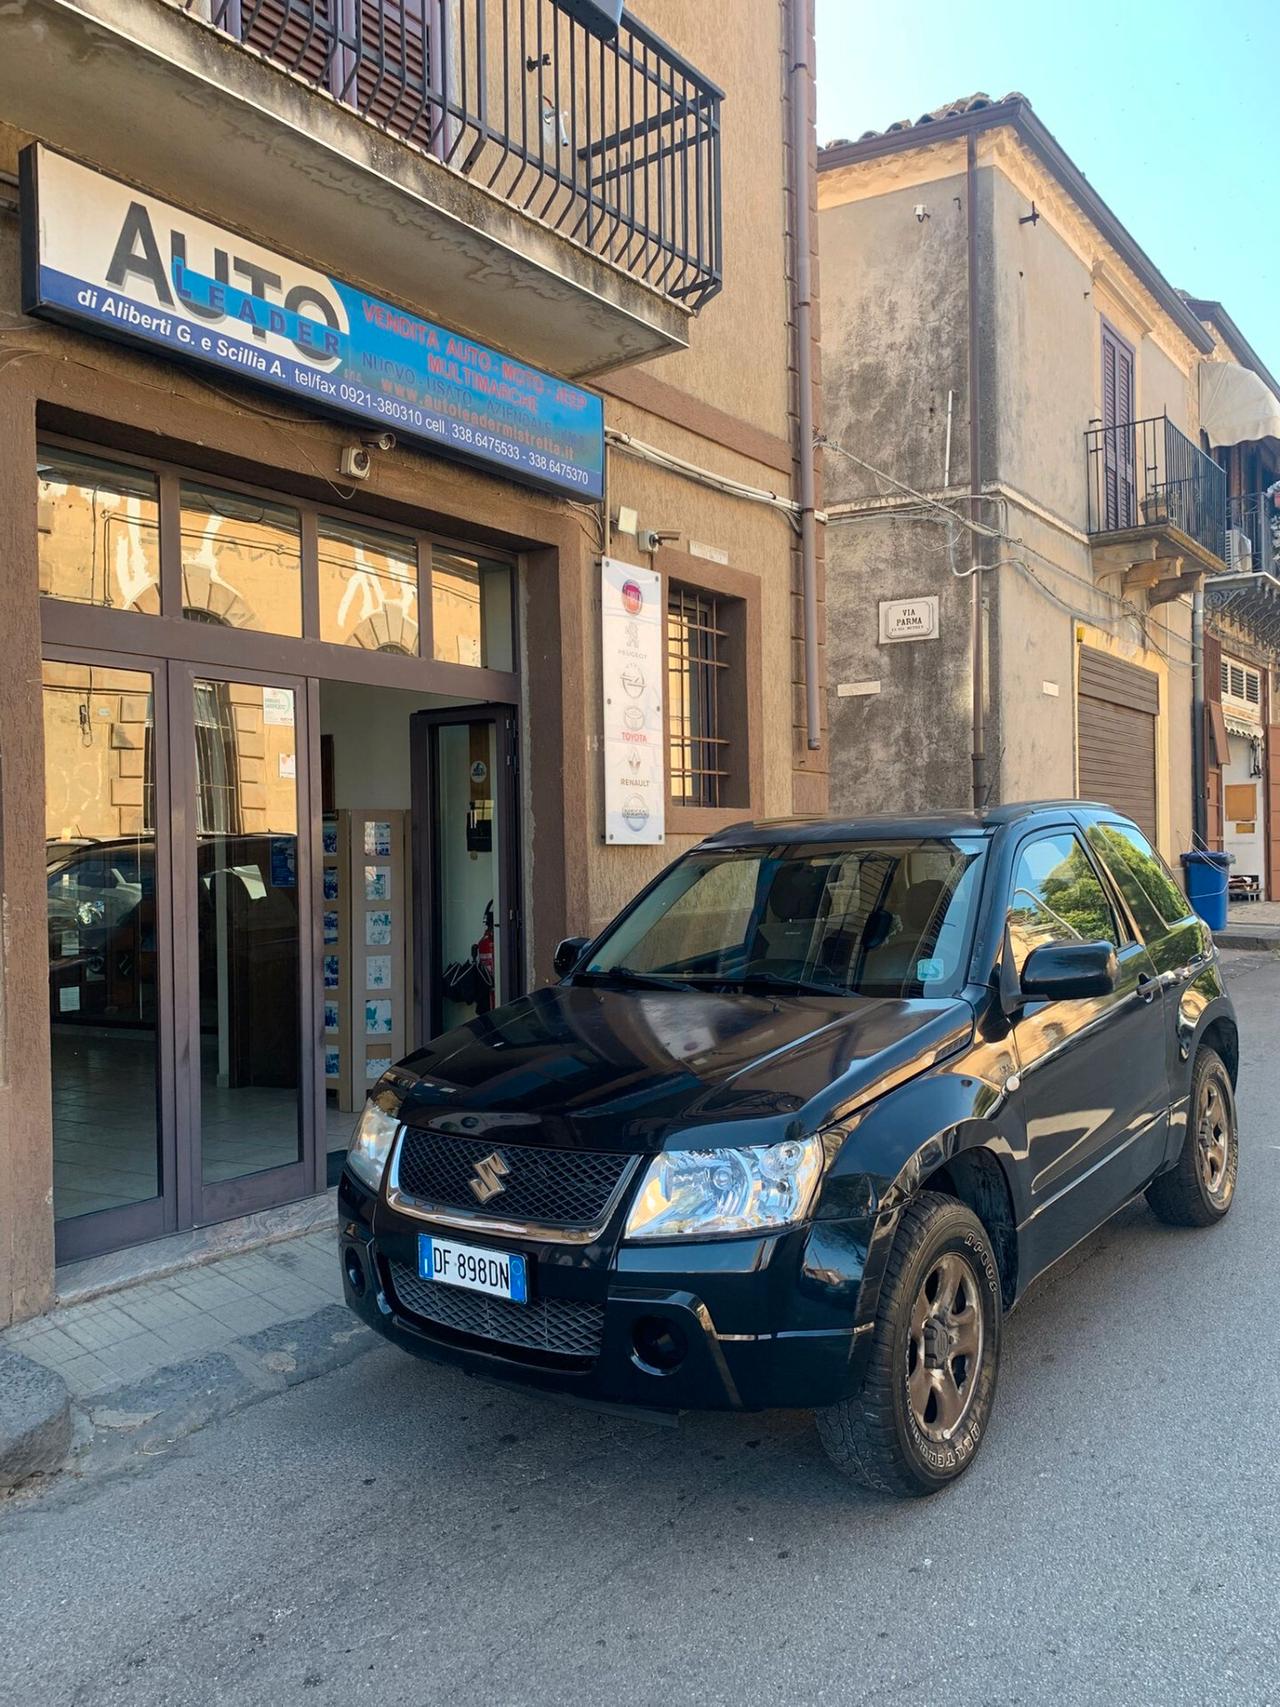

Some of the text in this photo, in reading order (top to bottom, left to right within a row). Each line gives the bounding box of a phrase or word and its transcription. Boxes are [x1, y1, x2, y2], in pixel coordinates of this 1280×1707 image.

[105, 201, 341, 361] AUTO
[173, 260, 340, 354] LEADER
[361, 299, 440, 351] VENDITA
[446, 337, 491, 371] AUTO
[502, 361, 545, 393] MOTO
[77, 289, 98, 309] di
[101, 297, 172, 336] Aliberti
[176, 325, 195, 345] G.
[201, 336, 212, 351] e
[216, 339, 266, 371] Scillia
[269, 360, 286, 378] A.
[294, 367, 337, 396] tel/fax
[340, 383, 422, 427] 0921-380310
[425, 417, 448, 437] cell.
[451, 422, 520, 461] 338.6475533
[528, 451, 589, 485] 338.6475370
[361, 352, 416, 385] NUOVO
[426, 375, 473, 406] USATO
[427, 352, 538, 414] MULTIMARCHE
[896, 616, 923, 627] PARMA
[902, 608, 916, 617] VIA
[621, 731, 648, 743] TOYOTA
[620, 778, 650, 788] RENAULT
[433, 1246, 510, 1290] DF 898DN
